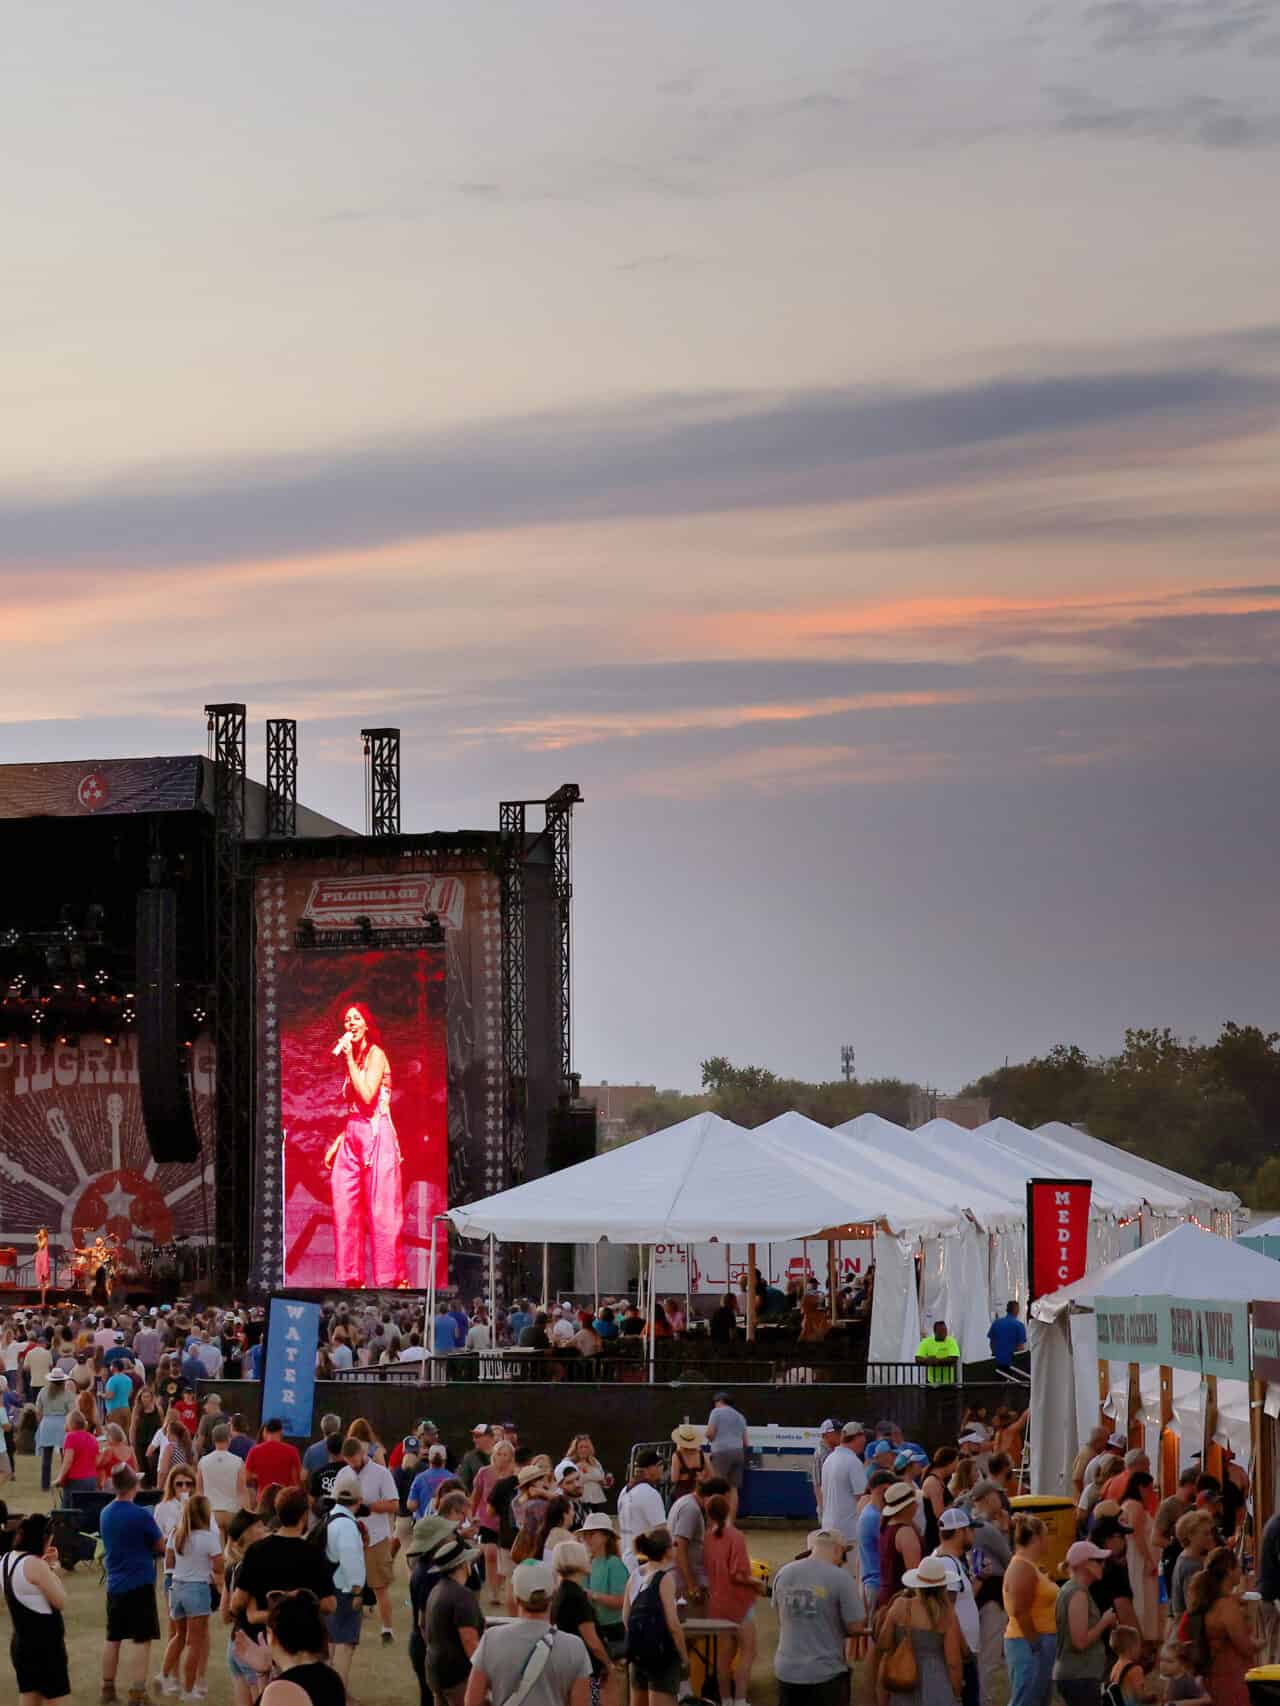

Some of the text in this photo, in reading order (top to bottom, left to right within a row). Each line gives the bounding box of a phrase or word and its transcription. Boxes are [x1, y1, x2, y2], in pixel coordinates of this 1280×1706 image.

[322, 888, 419, 902] PILGRIMAGE
[1055, 1191, 1071, 1288] MEDIC
[280, 1304, 305, 1405] WATER
